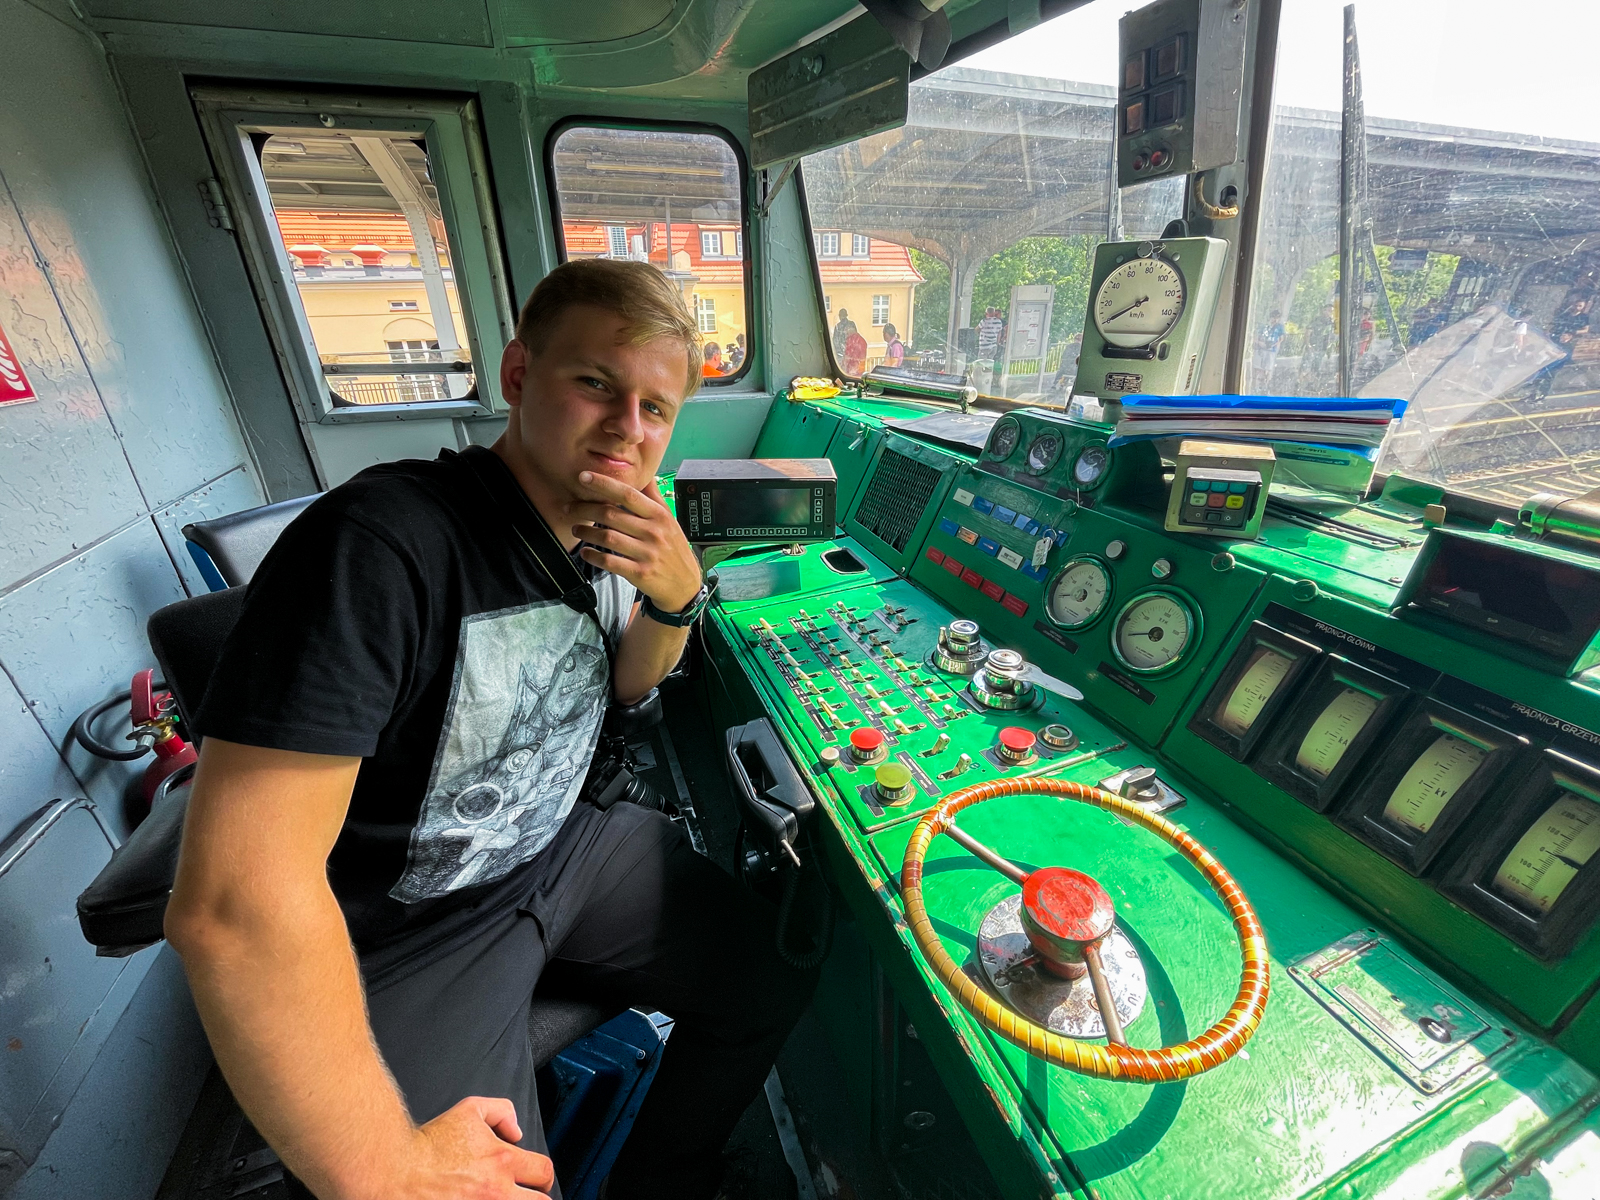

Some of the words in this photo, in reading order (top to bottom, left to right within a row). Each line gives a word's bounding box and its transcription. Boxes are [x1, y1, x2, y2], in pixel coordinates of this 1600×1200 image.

[1126, 270, 1136, 278] 60
[1145, 266, 1154, 274] 80
[1157, 273, 1169, 282] 100
[1164, 289, 1176, 298] 120
[1129, 311, 1145, 319] km/h
[1161, 308, 1173, 316] 140
[1511, 702, 1559, 728] PRĄDNICA
[1561, 723, 1600, 745] GRZEW
[1338, 736, 1349, 746] kA
[1435, 788, 1447, 798] kV
[1546, 826, 1559, 835] 100
[1520, 858, 1532, 868] 100
[1507, 874, 1520, 884] 200
